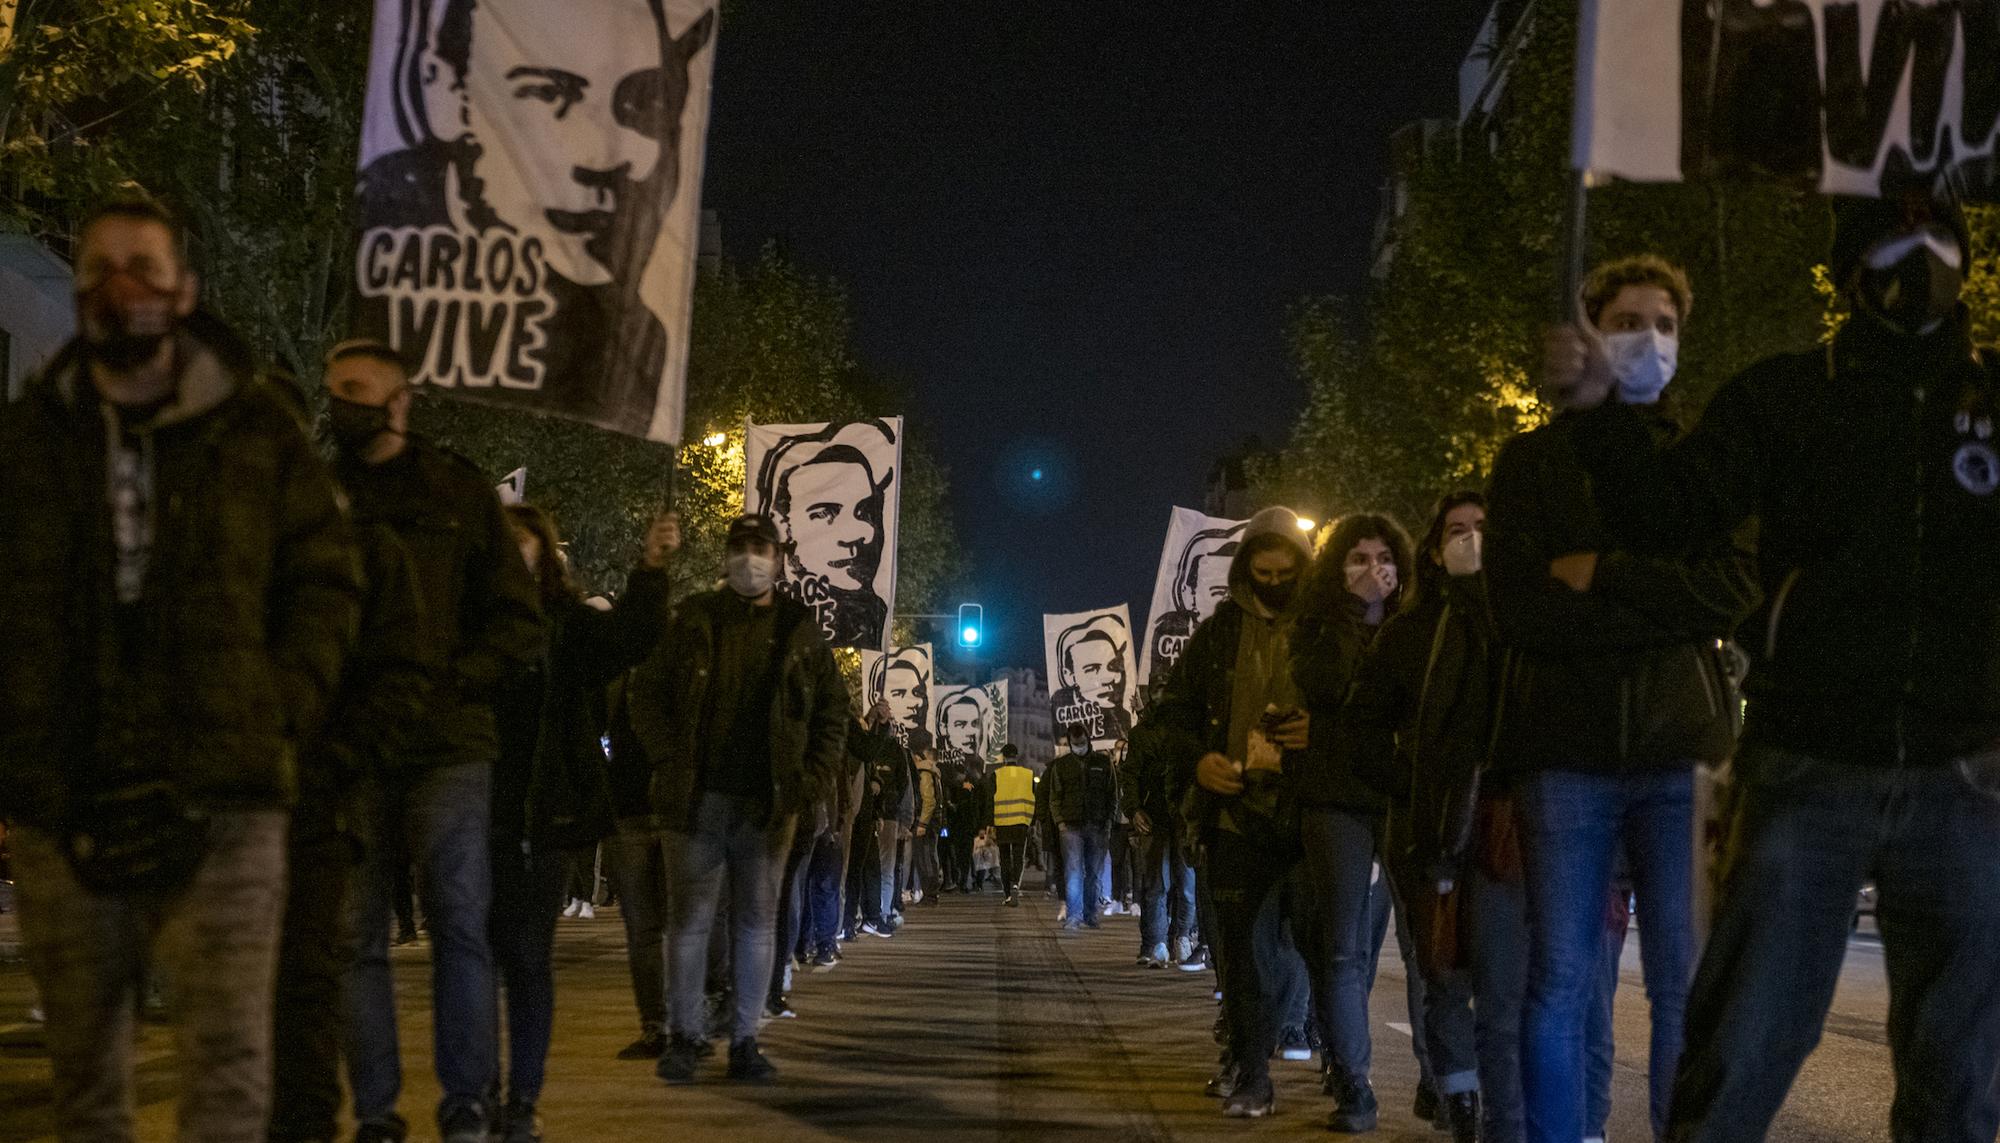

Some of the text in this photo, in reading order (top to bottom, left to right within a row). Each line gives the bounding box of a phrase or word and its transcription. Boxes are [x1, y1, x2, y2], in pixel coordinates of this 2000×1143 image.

[361, 227, 547, 298] CARLOS
[392, 297, 553, 386] VIVE
[1057, 701, 1100, 723] CARLOS
